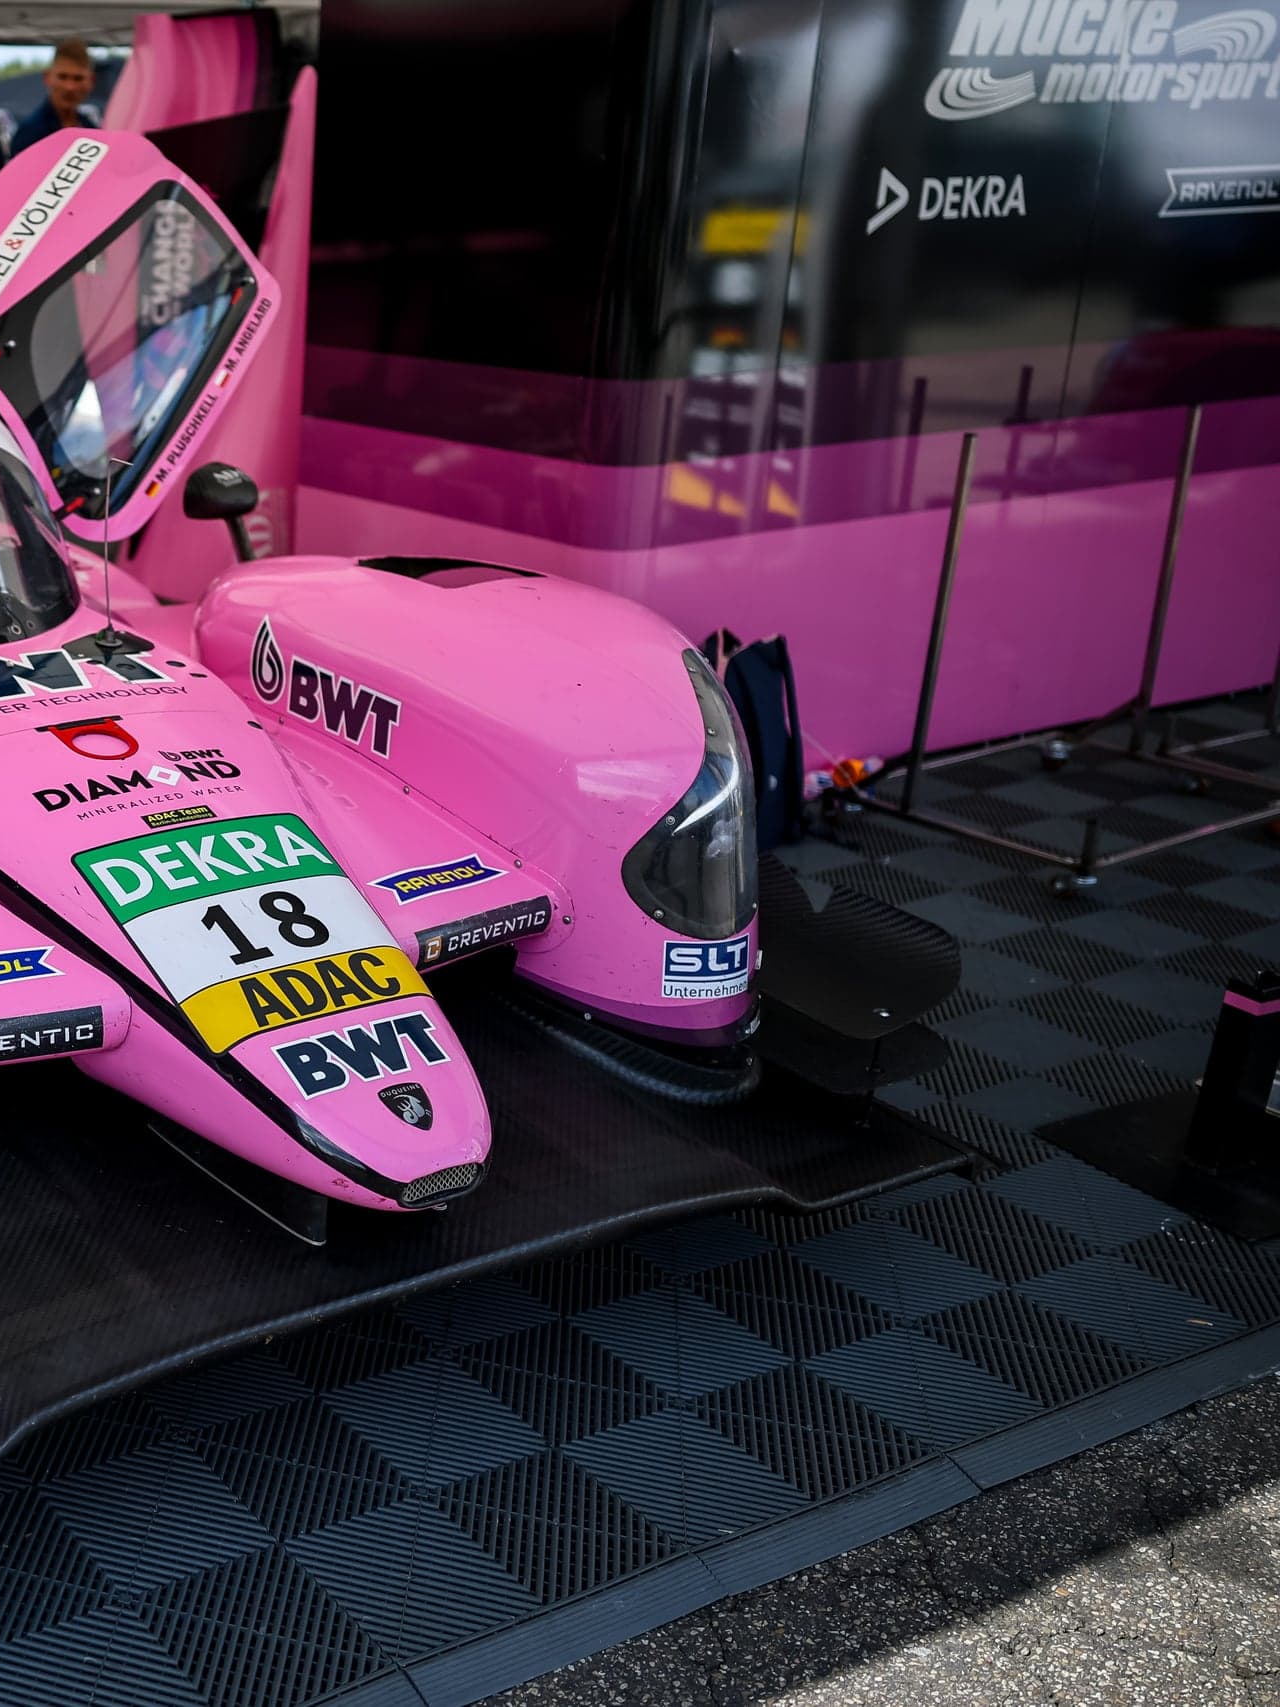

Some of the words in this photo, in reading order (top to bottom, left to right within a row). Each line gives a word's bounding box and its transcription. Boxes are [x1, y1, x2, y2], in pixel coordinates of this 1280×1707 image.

[1039, 62, 1280, 109] motorsport
[918, 174, 1027, 221] DEKRA
[1179, 180, 1279, 203] RAVENOL
[236, 296, 273, 356] ANGELARD
[167, 392, 220, 465] PLUSCHKELL
[31, 684, 189, 709] TECHNOLOGY
[287, 659, 403, 761] BWT
[179, 748, 226, 761] BWT
[76, 792, 184, 821] MINERALIZED
[191, 785, 245, 797] WATER
[147, 810, 180, 823] ADAC
[180, 805, 209, 816] Team
[89, 824, 333, 907] DEKRA
[394, 865, 484, 893] RAVENOL
[200, 890, 330, 965] 18
[447, 910, 547, 953] CREVENTIC
[669, 941, 747, 972] SLT
[239, 952, 401, 1028] ADAC
[272, 1012, 451, 1099] BWT
[380, 1083, 421, 1098] DUQUEINE
